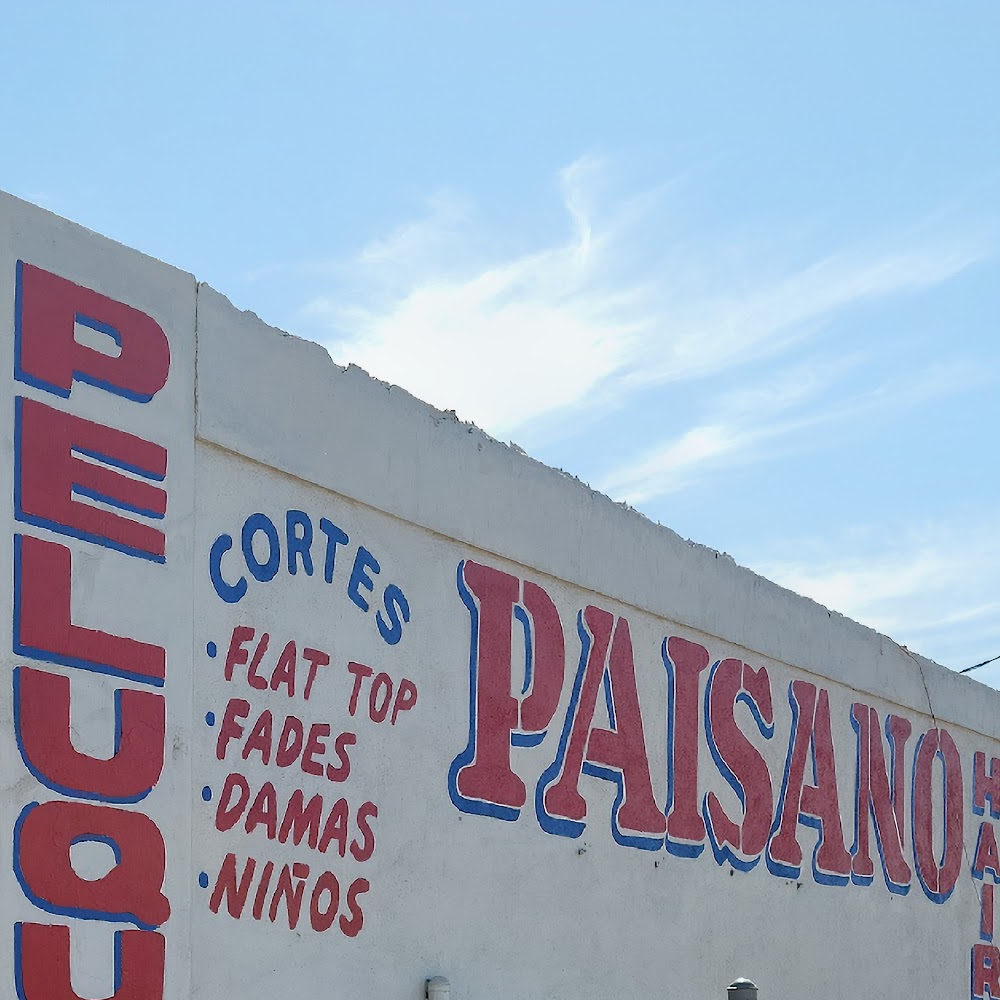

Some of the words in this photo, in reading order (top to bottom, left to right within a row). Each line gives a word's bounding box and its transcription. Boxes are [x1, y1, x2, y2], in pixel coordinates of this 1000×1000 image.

[209, 509, 410, 646] CORTES
[223, 625, 331, 701] FLAT
[347, 661, 419, 726] TOP
[215, 698, 357, 783] FADES
[447, 558, 965, 904] PAISANO
[214, 772, 379, 863] DAMAS
[208, 852, 370, 938] NIÑOS
